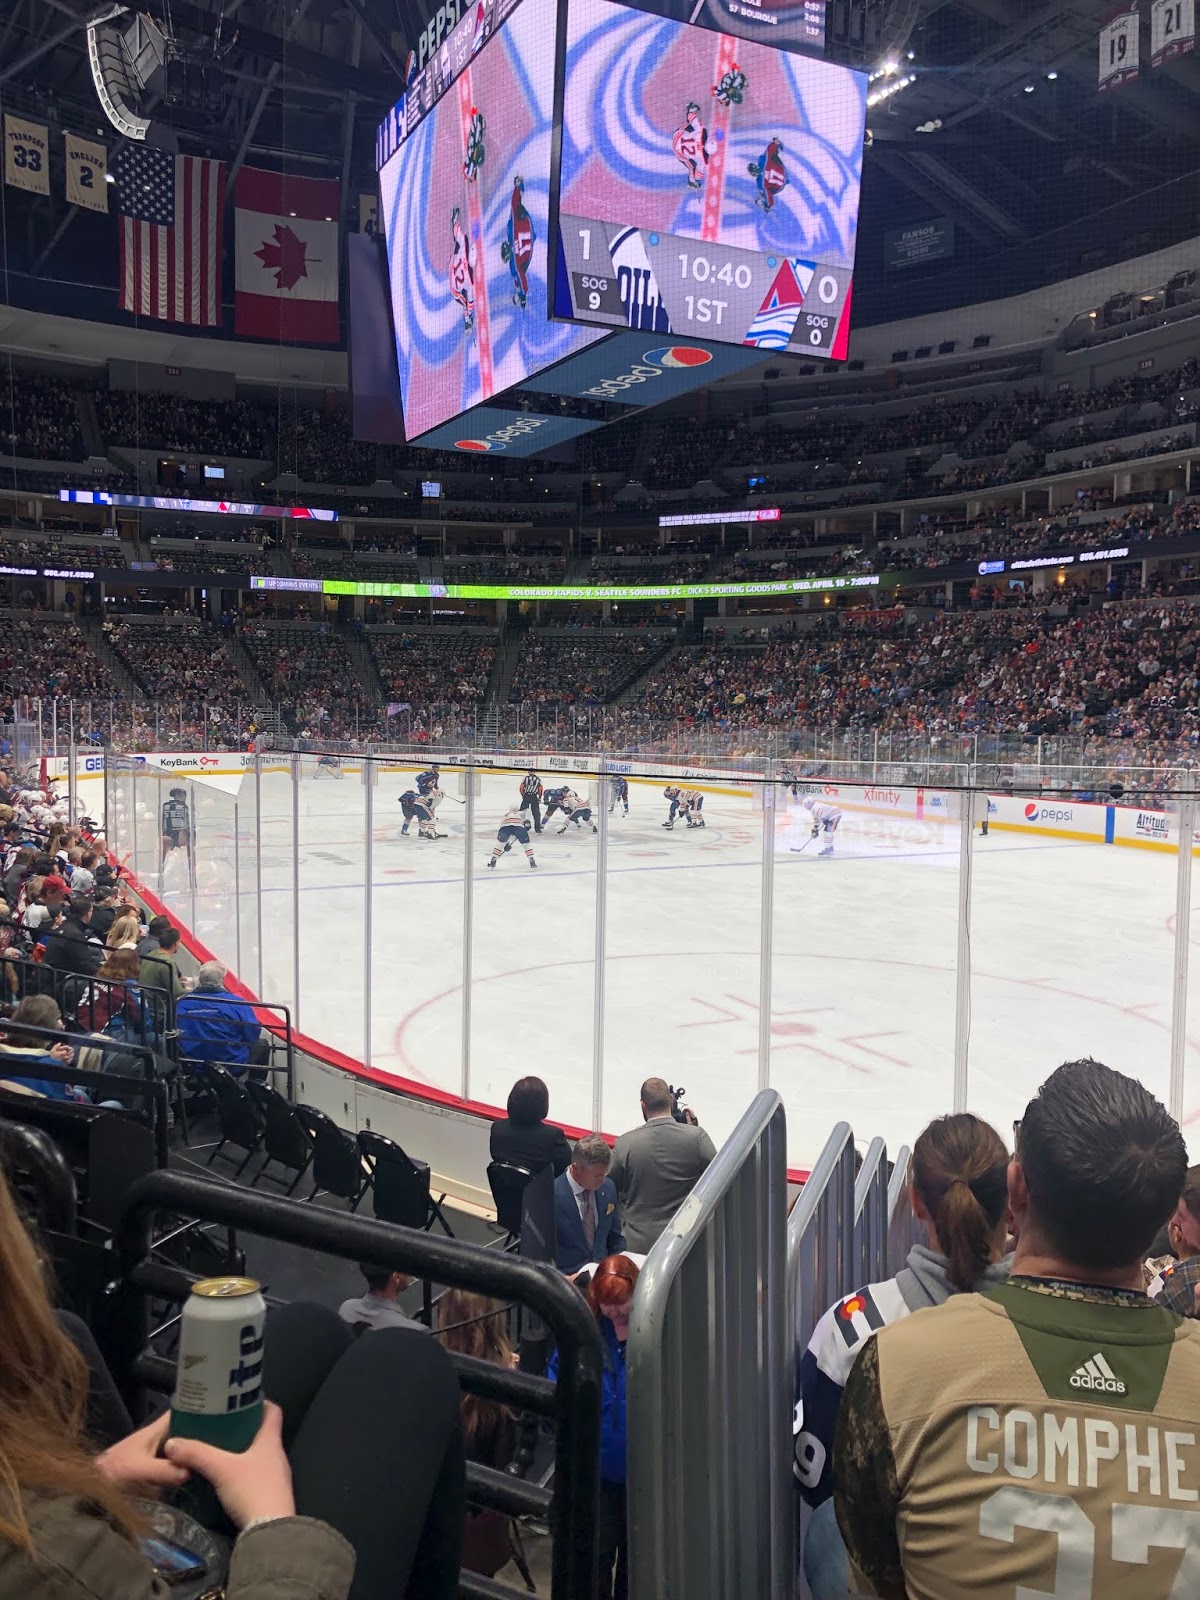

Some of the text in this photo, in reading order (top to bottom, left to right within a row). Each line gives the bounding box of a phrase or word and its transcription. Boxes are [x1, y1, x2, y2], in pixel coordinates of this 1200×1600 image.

[728, 4, 778, 25] 57 BOURQUE
[1165, 3, 1181, 36] 21
[418, 0, 461, 71] PEPSI
[1110, 34, 1126, 65] 19
[681, 137, 696, 157] 12
[13, 144, 42, 172] 33
[80, 165, 94, 189] 2
[578, 229, 591, 260] 1
[453, 258, 465, 288] 12
[678, 253, 752, 290] 10:40
[581, 276, 608, 291] SOG
[818, 275, 839, 304] 0
[588, 291, 601, 310] 9
[684, 295, 728, 325] 1ST
[806, 315, 829, 328] SOG
[810, 329, 822, 345] 0
[578, 364, 663, 398] pepsi
[485, 417, 549, 443] pepsi
[268, 580, 319, 590] UPCOMING EVENTS
[509, 588, 553, 596] COLORADO
[594, 588, 628, 596] SEATTLE
[630, 587, 670, 596] SOUNDERS
[672, 587, 682, 595] FC
[687, 586, 709, 594] DICK'S
[711, 585, 744, 594] SPORTING
[746, 584, 770, 593] GOODS
[771, 584, 787, 592] PARK
[792, 581, 812, 591] WED.
[812, 579, 834, 589] APRIL
[851, 576, 879, 587] 7:00PM
[160, 758, 198, 768] KeyBank
[616, 763, 632, 773] LIGHT
[863, 786, 901, 807] xfinity
[1040, 808, 1073, 822] pepsi
[1069, 1373, 1126, 1394] adidas
